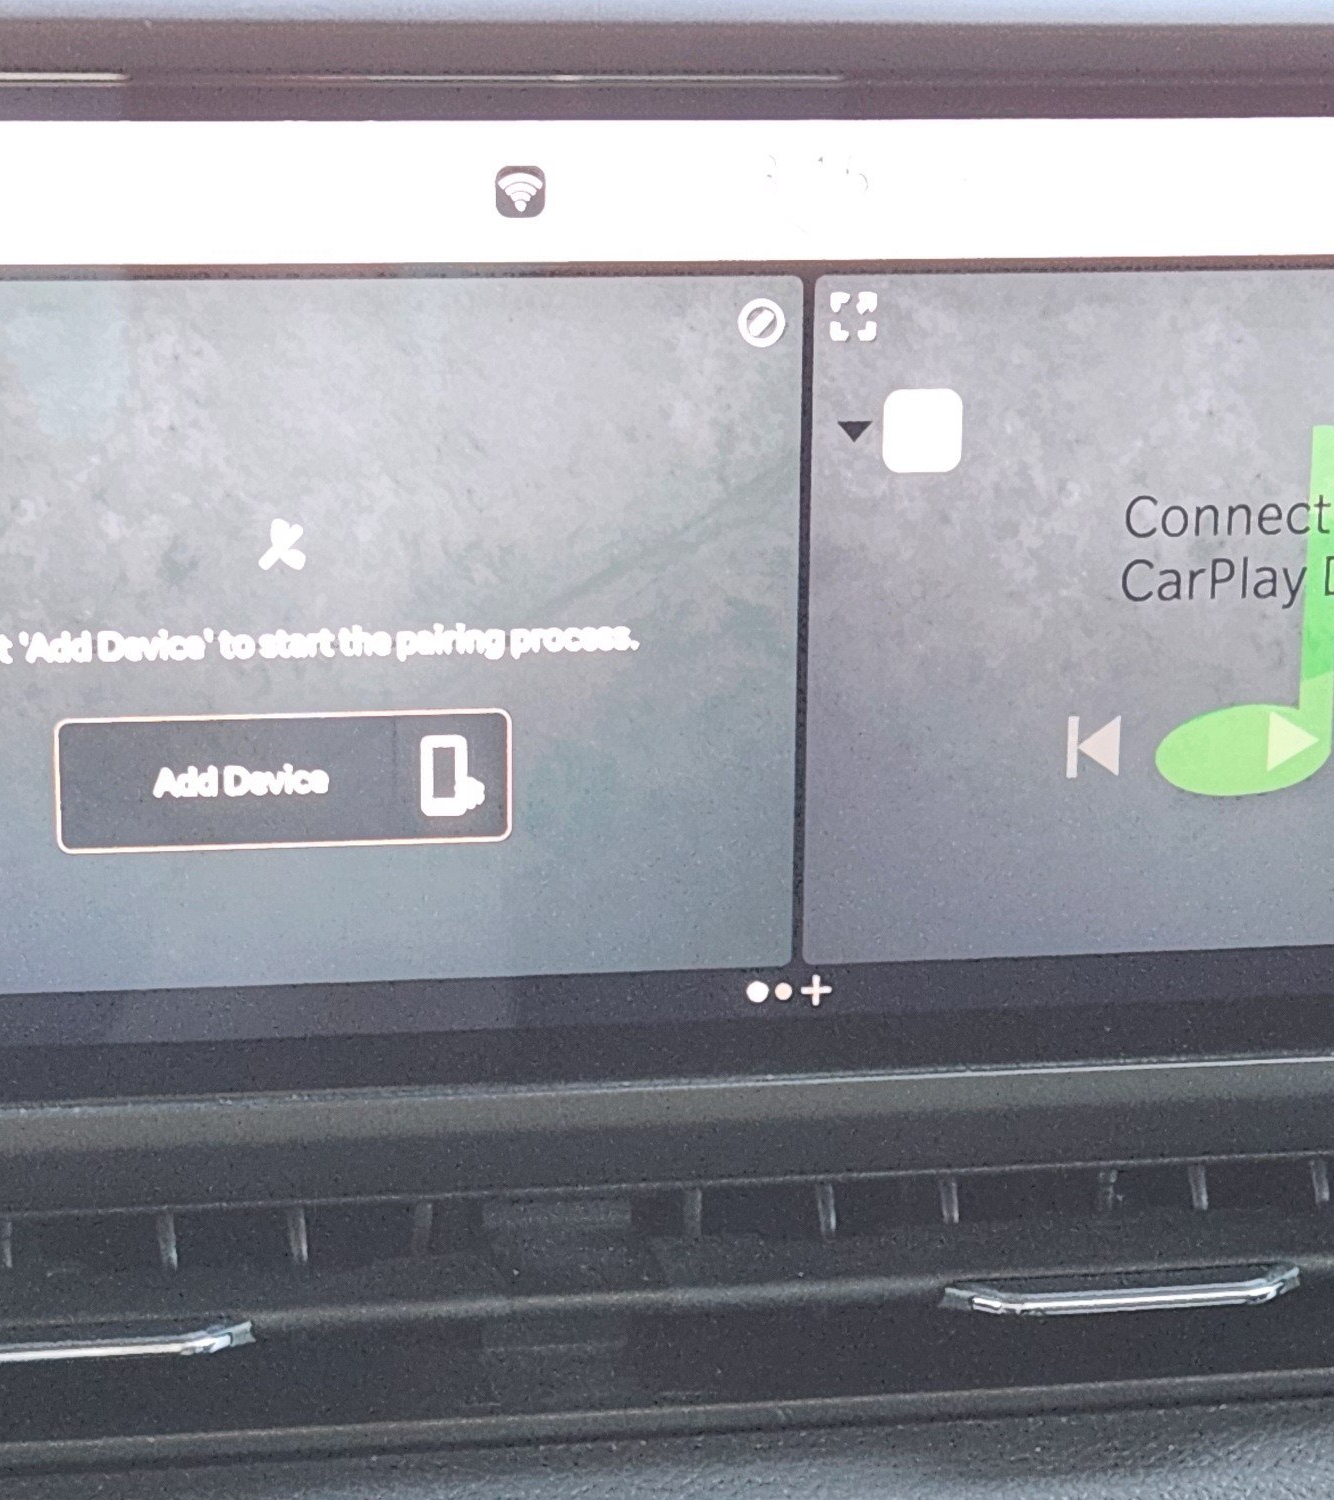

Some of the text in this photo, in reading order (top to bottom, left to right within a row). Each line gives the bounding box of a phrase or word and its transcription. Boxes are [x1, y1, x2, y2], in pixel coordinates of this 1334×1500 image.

[1124, 492, 1332, 539] Connect
[1120, 557, 1308, 609] CarPlay
[219, 630, 255, 660] to
[257, 627, 335, 658] start
[338, 624, 393, 657] the
[396, 622, 506, 661] pairing
[509, 624, 640, 657] process.
[151, 763, 330, 798] Add Device
